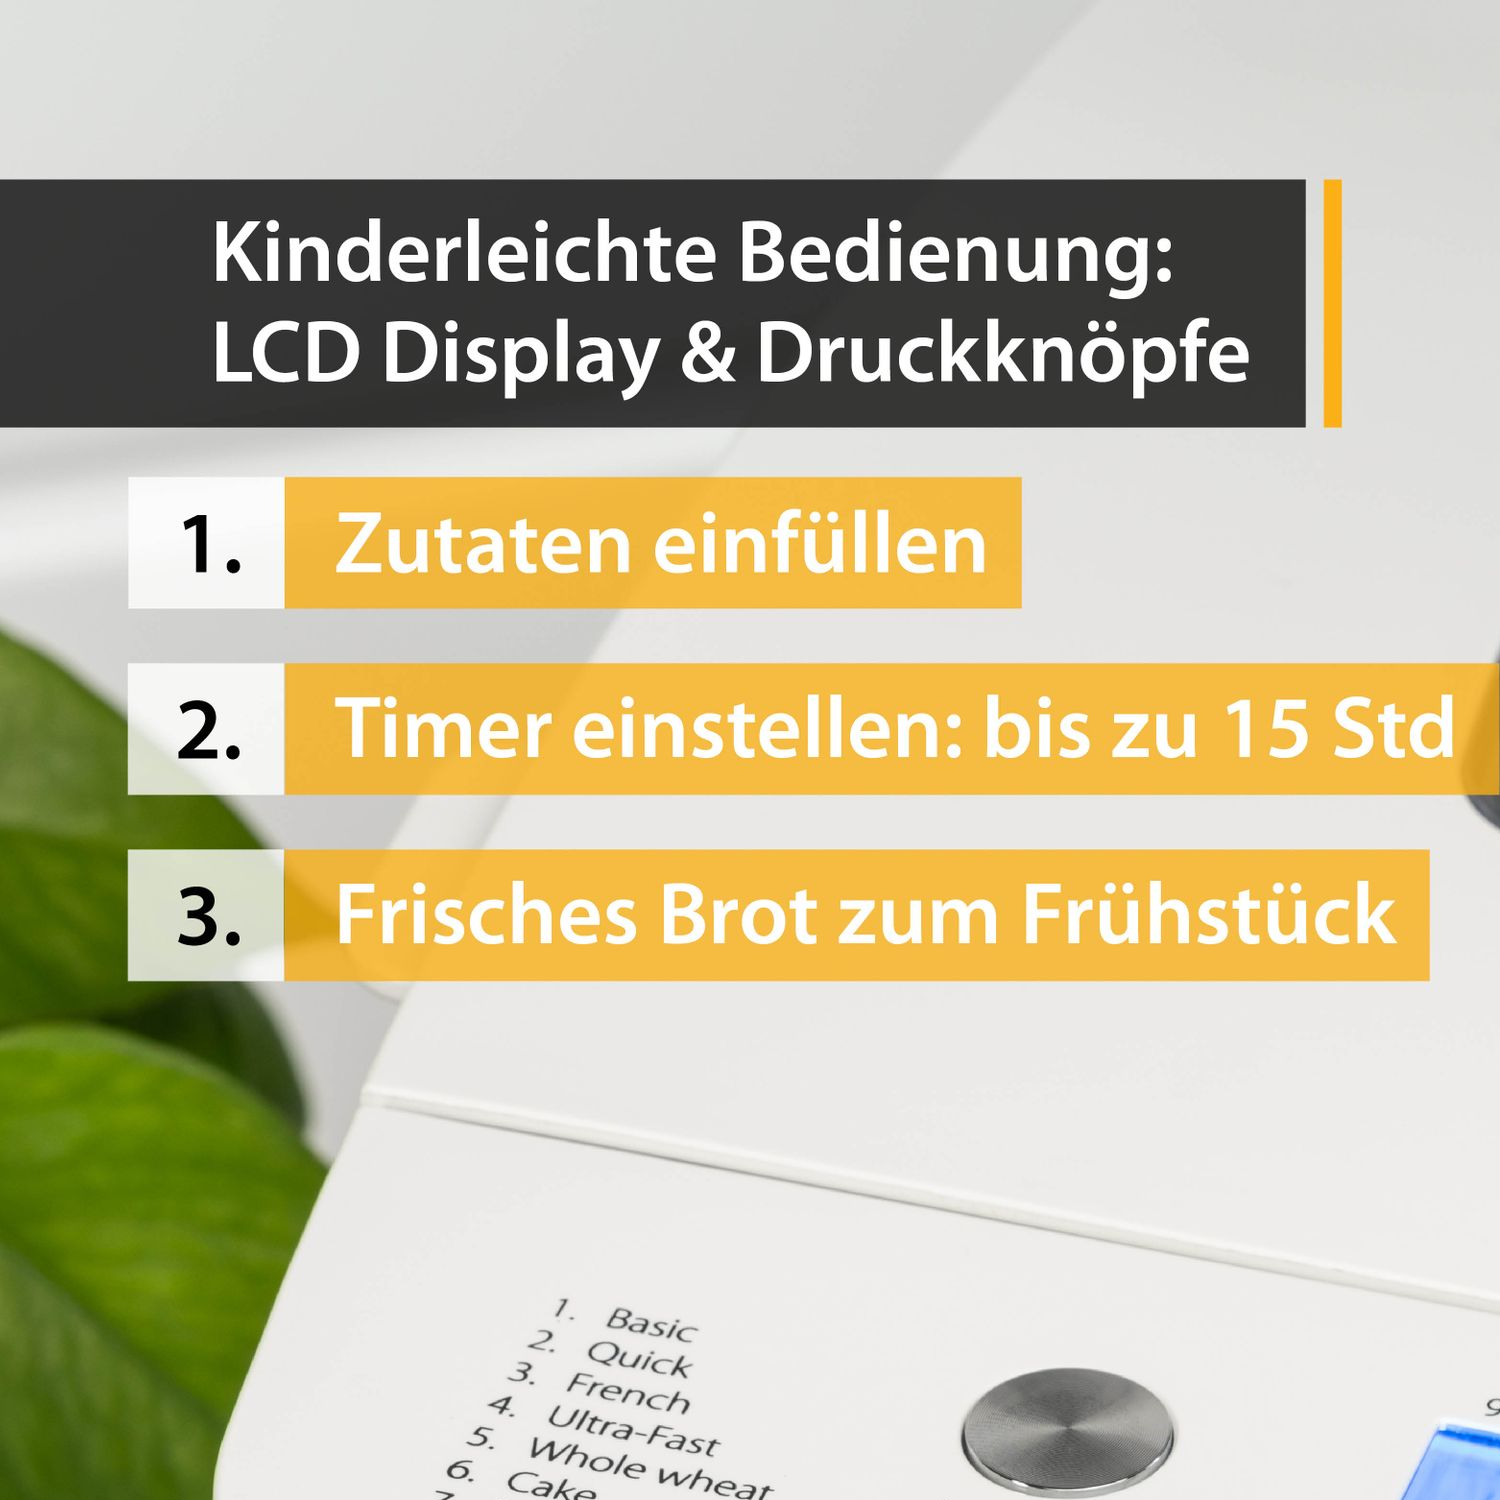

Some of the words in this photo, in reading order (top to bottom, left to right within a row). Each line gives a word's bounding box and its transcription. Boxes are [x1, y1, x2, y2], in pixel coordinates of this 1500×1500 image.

[556, 1298, 574, 1321] 1.
[607, 1308, 698, 1342] Basic
[528, 1330, 554, 1352] 2.
[588, 1342, 692, 1378] Quick
[508, 1362, 534, 1385] 3.
[567, 1373, 690, 1414] French
[488, 1396, 514, 1417] 4.
[549, 1406, 720, 1457] Ultra-Fast
[447, 1460, 473, 1482] 6.
[466, 1427, 494, 1449] 5.
[531, 1437, 646, 1479] Whole
